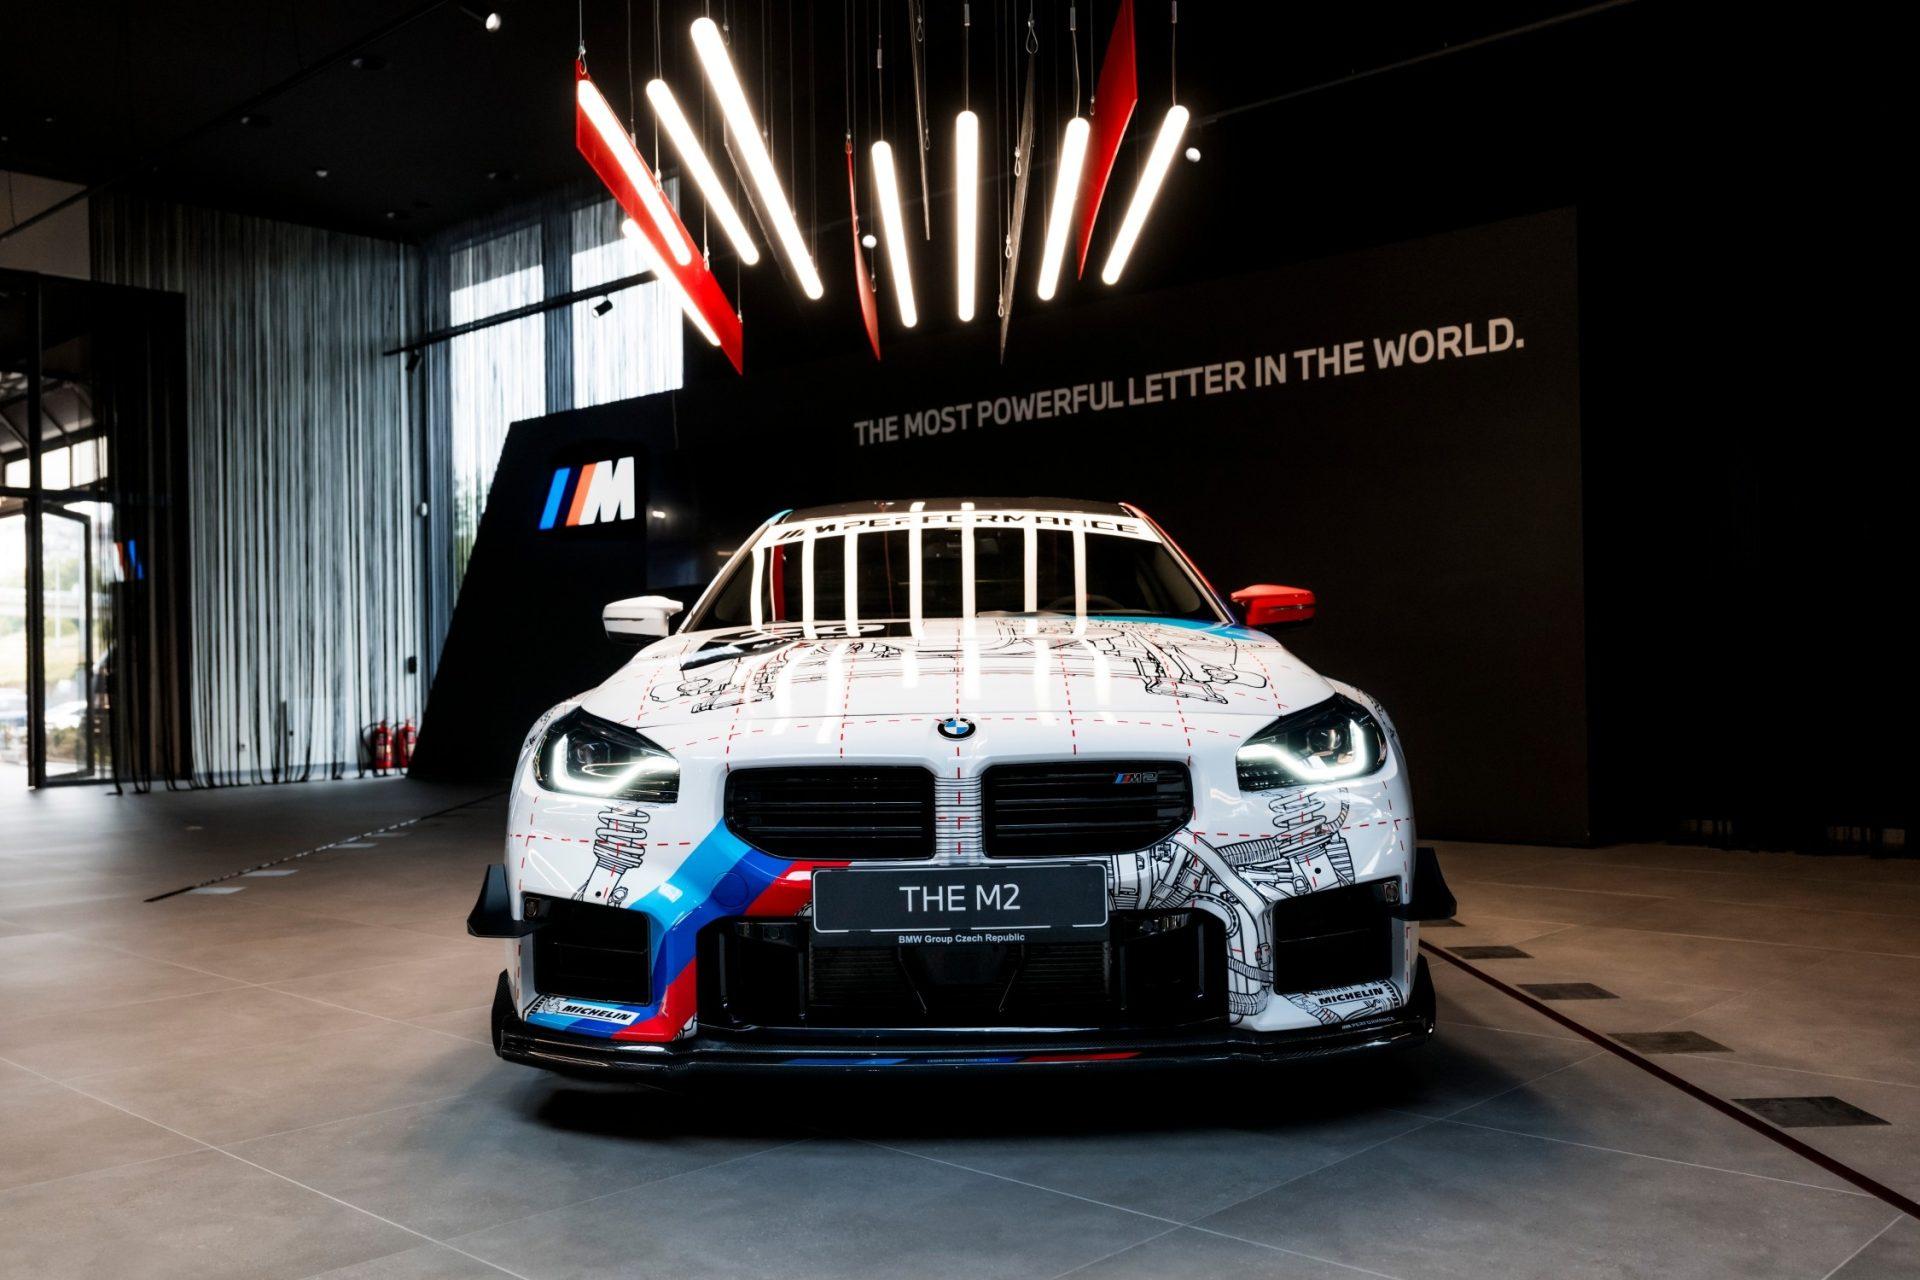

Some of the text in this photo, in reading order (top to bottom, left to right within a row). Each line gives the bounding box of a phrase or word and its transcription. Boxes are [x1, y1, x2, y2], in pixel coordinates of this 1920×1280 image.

[854, 317, 1525, 446] THE MOST POWERFUL LETTER IN THE WORLD.
[899, 883, 1021, 912] THE M2
[898, 932, 1025, 945] BMW Group Czech Republic
[1319, 987, 1384, 1005] MICHELIN
[562, 1005, 632, 1021] MICHELIN
